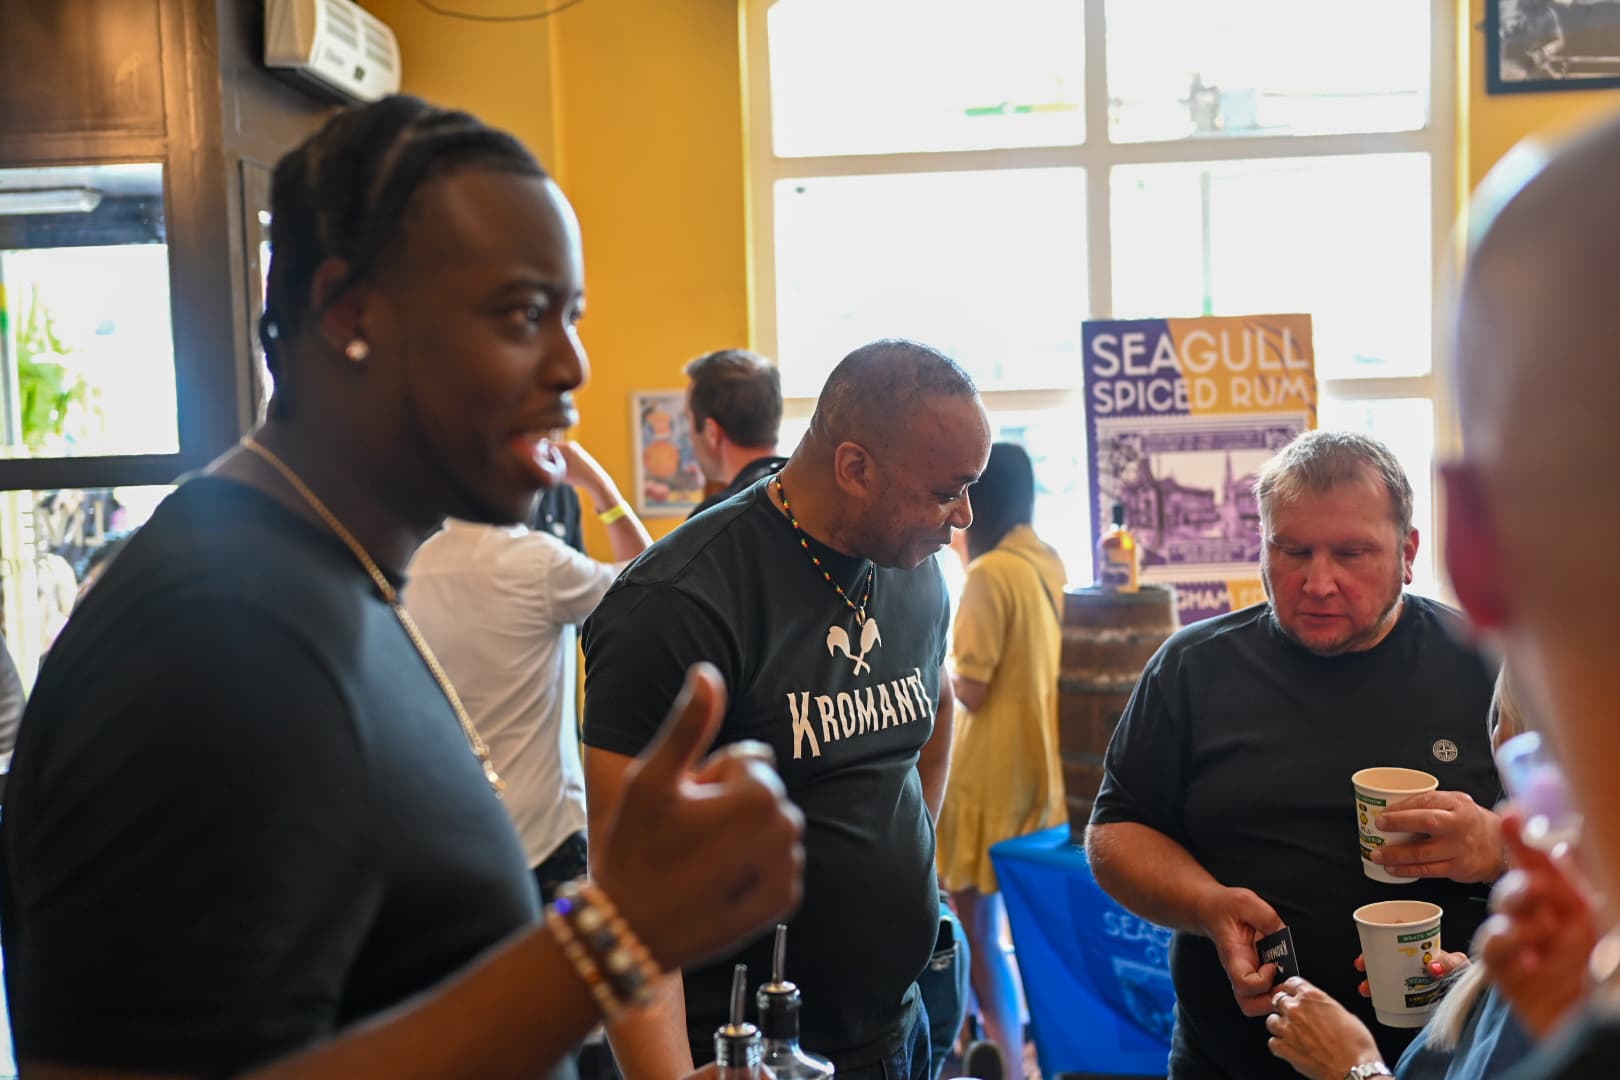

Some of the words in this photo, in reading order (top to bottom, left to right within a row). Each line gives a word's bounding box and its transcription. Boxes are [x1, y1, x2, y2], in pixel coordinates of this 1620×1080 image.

[1091, 328, 1309, 378] SEAGULL
[1093, 377, 1218, 413] SPICED
[1231, 375, 1310, 408] RUM
